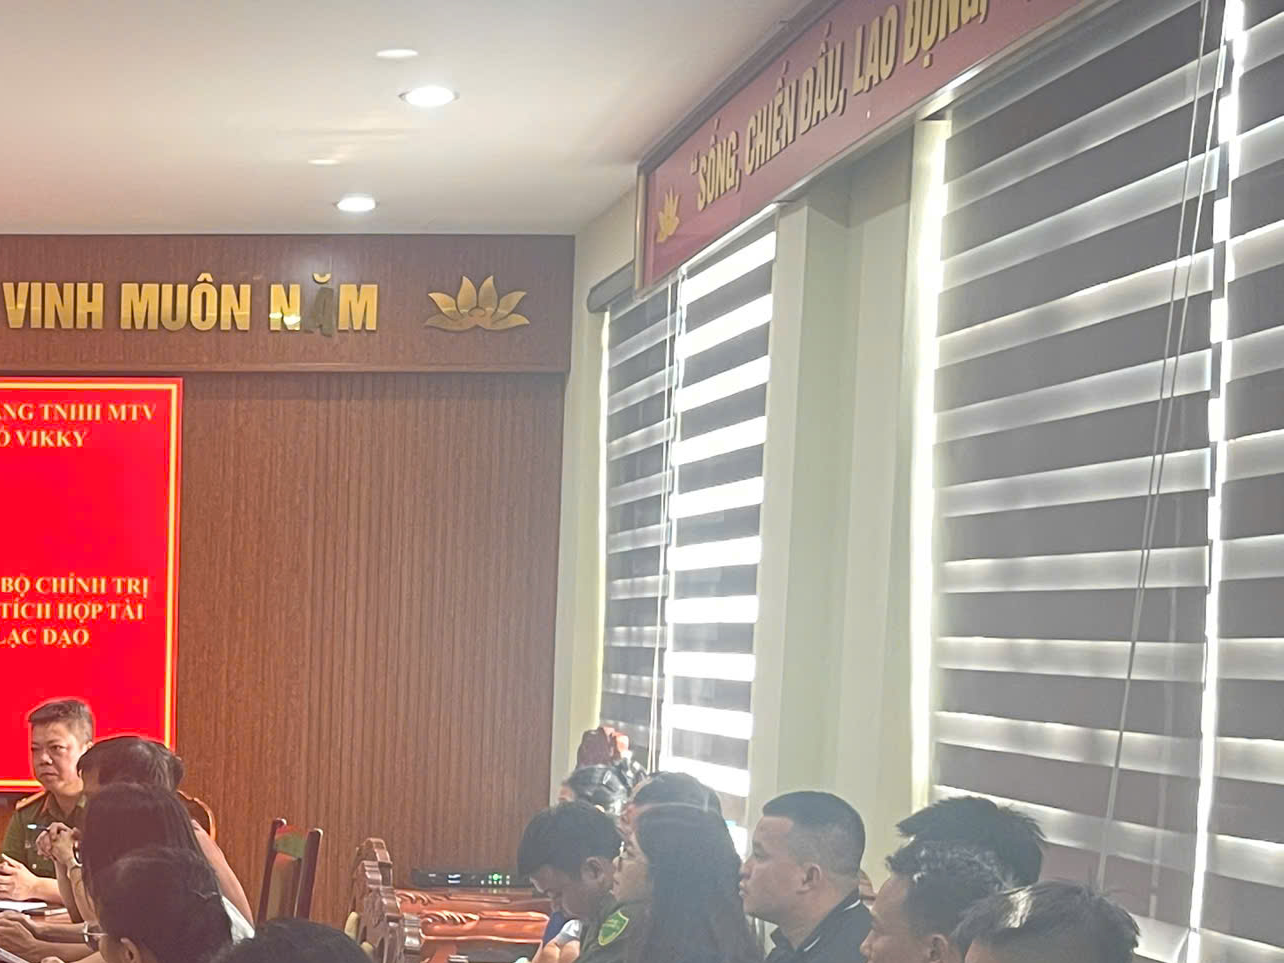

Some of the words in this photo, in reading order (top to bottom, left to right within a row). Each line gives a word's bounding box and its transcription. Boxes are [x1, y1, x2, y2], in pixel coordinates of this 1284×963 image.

[744, 59, 800, 177] CHIẾN
[851, 4, 900, 97] LAO
[2, 281, 104, 330] VINH
[120, 272, 251, 331] MUÔN
[270, 272, 379, 337] NĂM
[39, 403, 102, 422] TNHH
[108, 403, 157, 422] MTV
[15, 429, 89, 448] VIKKY
[0, 572, 32, 598] BỘ
[35, 571, 107, 595] CHÍNH
[112, 576, 150, 599] TRỊ
[58, 599, 104, 624] HỢP
[105, 598, 144, 621] TÀI
[42, 627, 91, 649] ĐẠO
